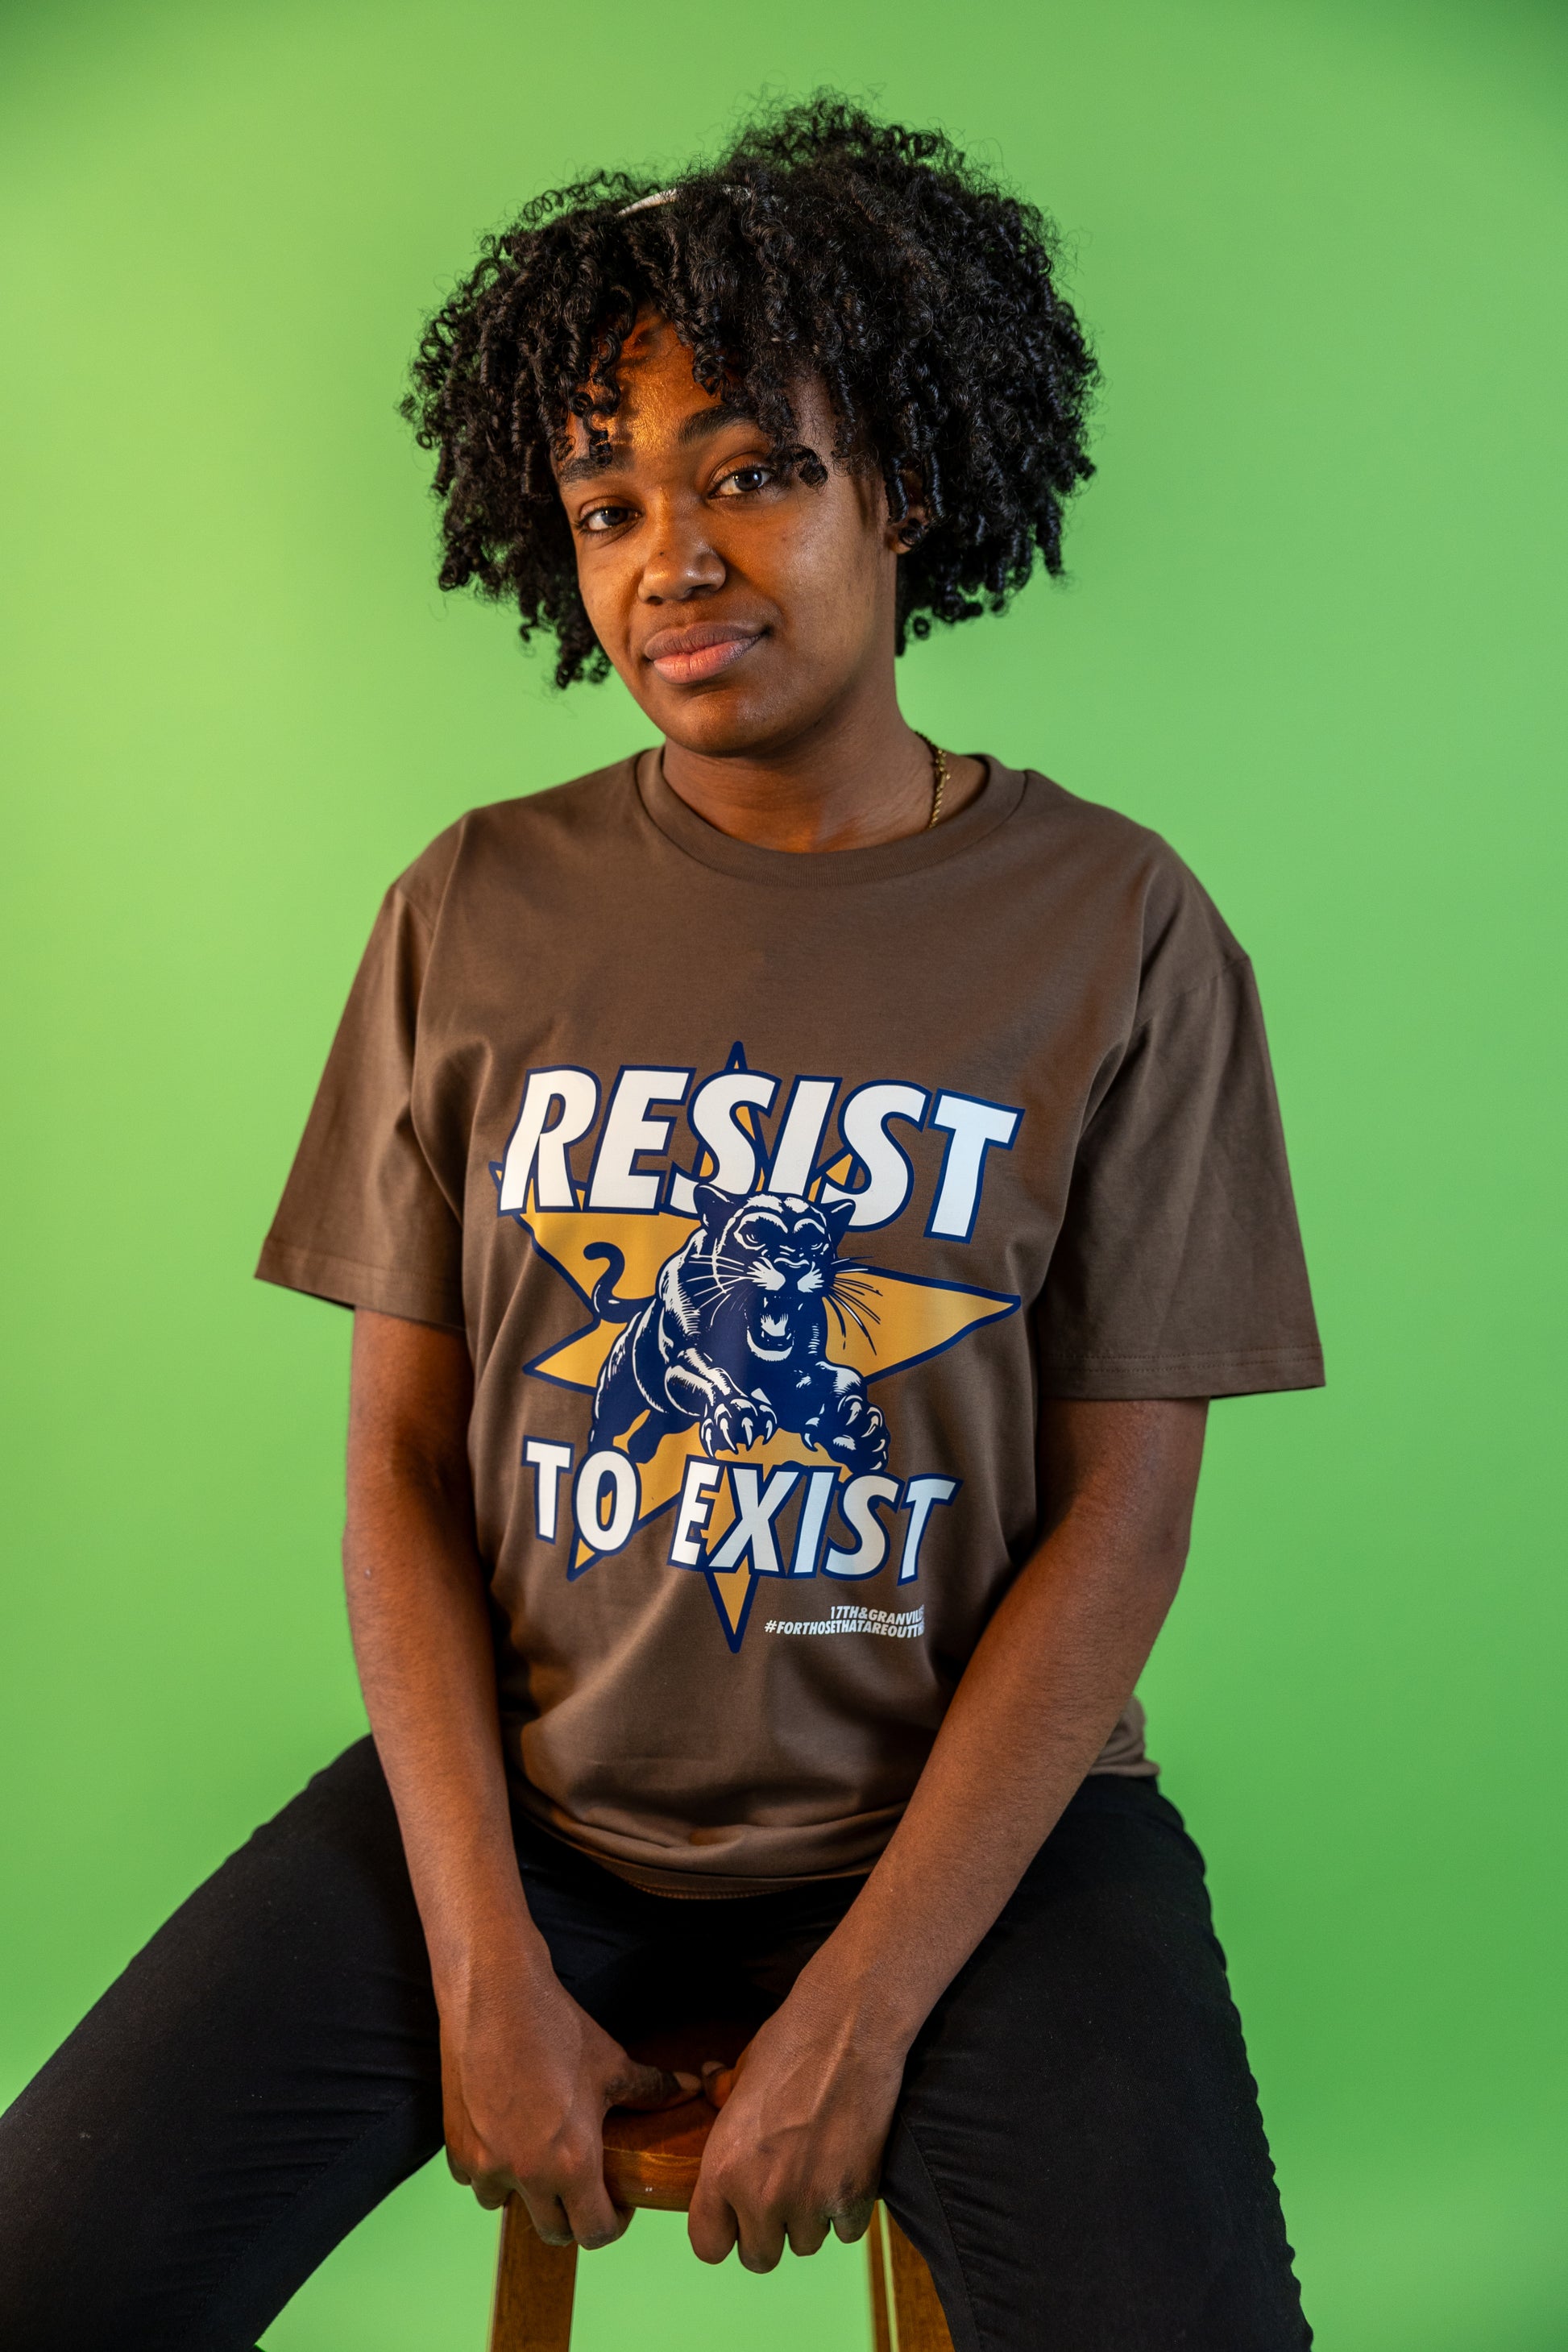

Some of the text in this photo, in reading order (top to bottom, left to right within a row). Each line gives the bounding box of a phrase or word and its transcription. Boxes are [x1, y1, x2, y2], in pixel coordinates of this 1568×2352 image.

[498, 1066, 1024, 1242] RESIST
[524, 1438, 961, 1584] TO EXIST
